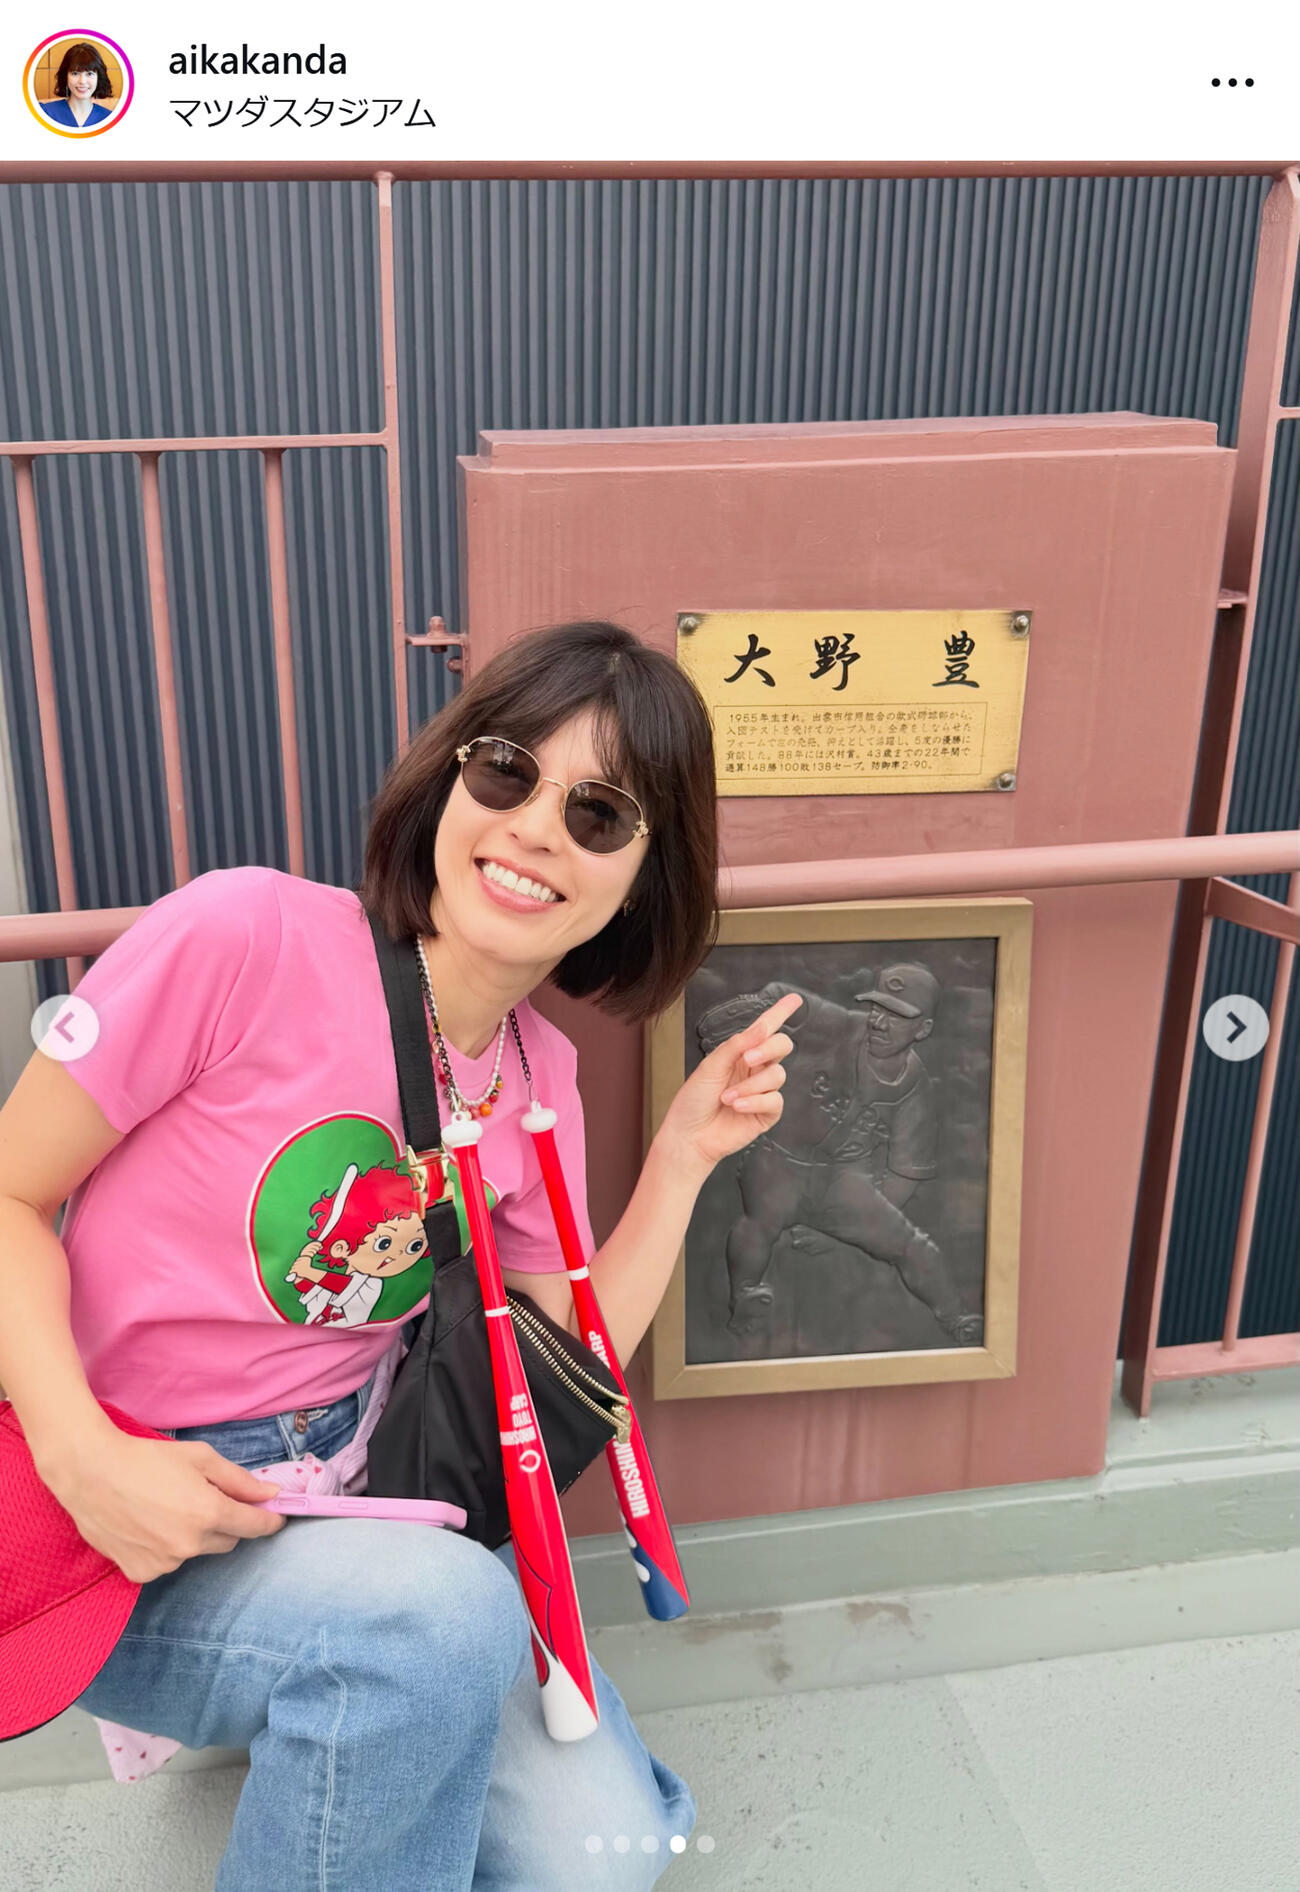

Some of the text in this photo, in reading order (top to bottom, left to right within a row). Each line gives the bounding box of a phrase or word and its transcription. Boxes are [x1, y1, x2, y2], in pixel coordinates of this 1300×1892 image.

[724, 630, 980, 691] 大野 豊
[588, 1331, 610, 1370] ARP
